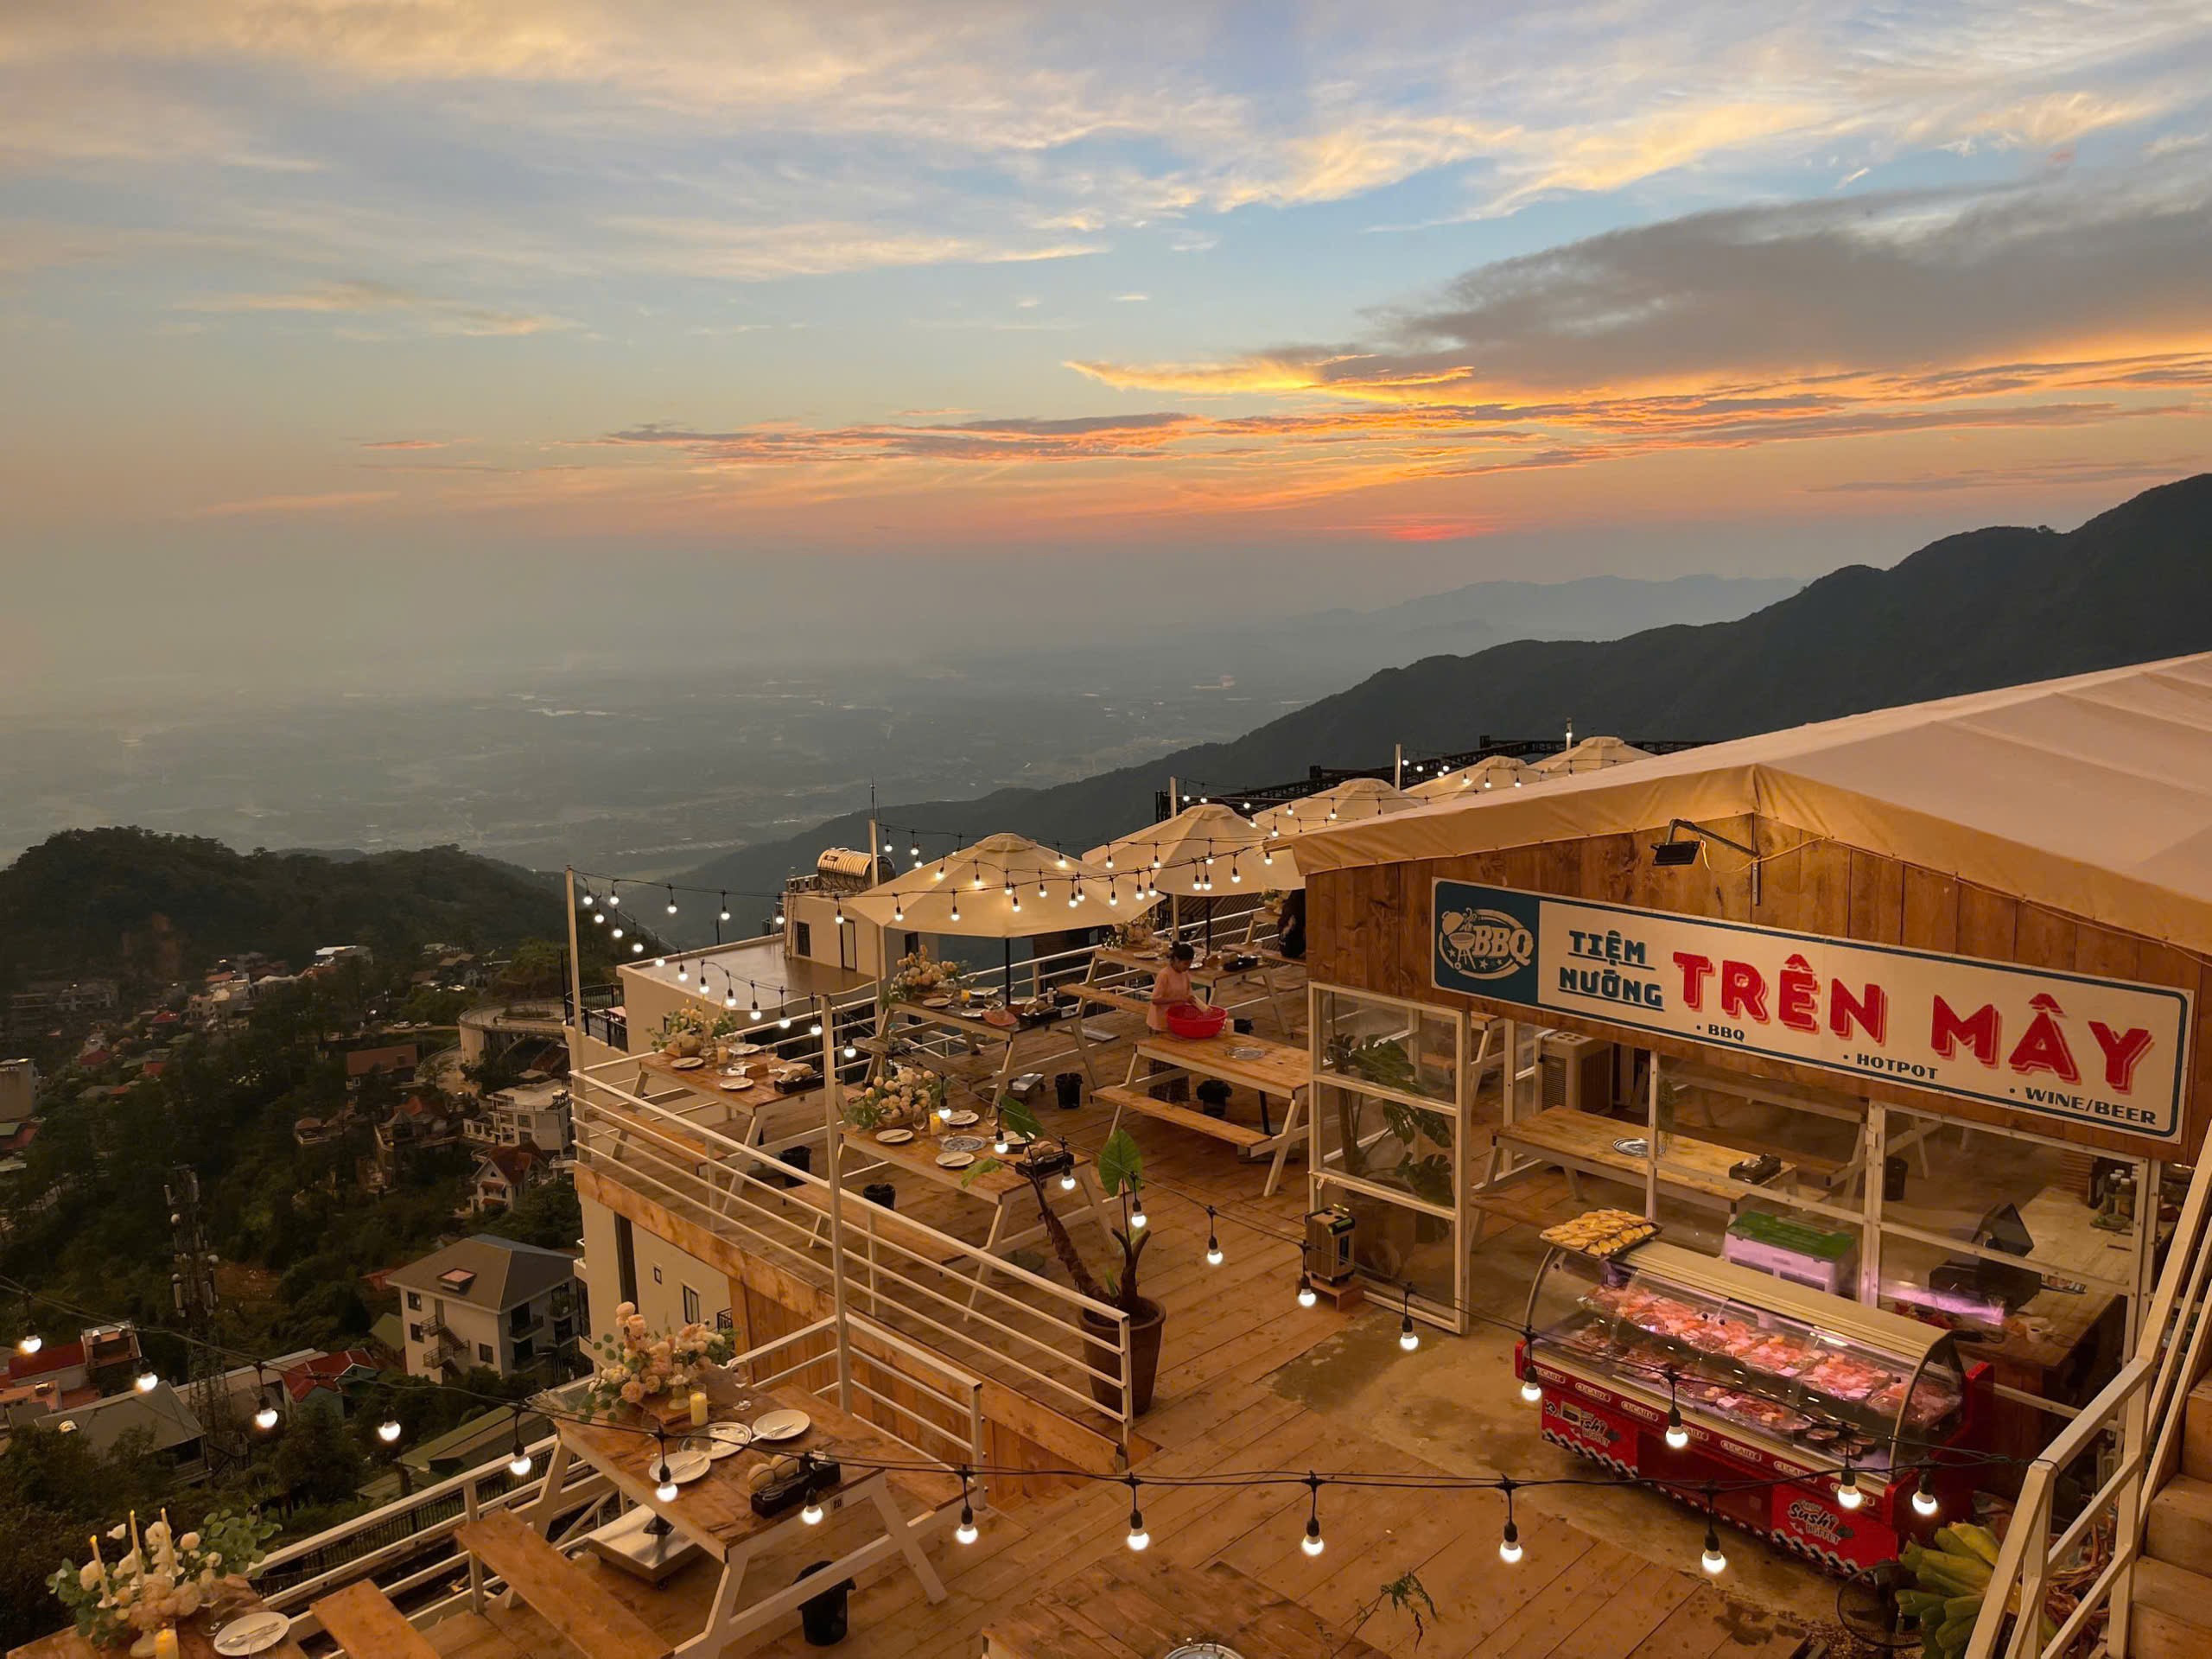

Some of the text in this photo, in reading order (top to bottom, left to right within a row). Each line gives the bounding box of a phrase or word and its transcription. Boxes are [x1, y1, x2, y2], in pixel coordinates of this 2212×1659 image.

[1472, 925, 1534, 966] BBQ
[1569, 930, 1646, 966] TIỆM
[1673, 951, 2155, 1096] TRÊN MÂY
[1708, 1024, 1745, 1042] BBQ
[1857, 1053, 1938, 1079] HOTPOT
[2025, 1087, 2156, 1125] WINE/BEER
